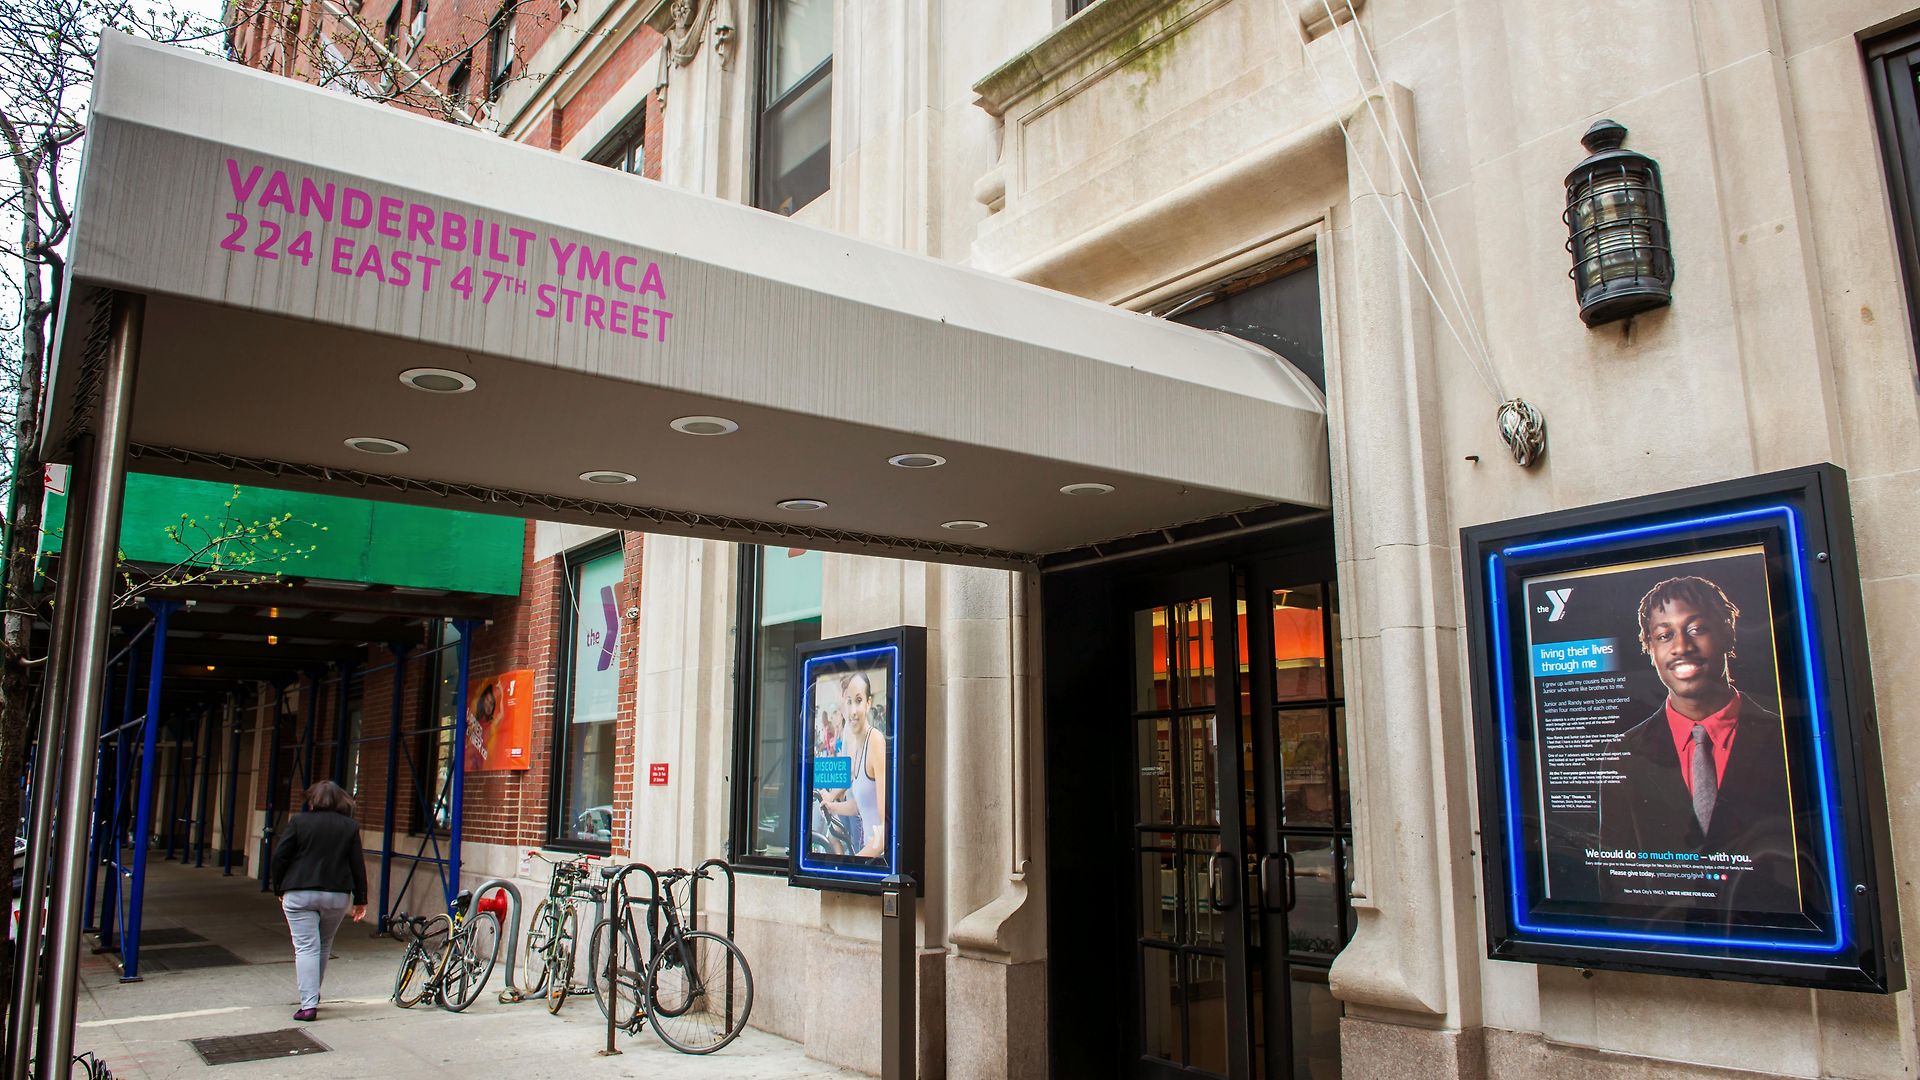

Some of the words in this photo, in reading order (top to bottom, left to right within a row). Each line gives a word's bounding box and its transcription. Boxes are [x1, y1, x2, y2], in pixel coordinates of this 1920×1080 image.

[226, 158, 537, 267] VANDERBILT
[549, 237, 667, 300] YMCA
[220, 212, 314, 266] 224
[331, 237, 441, 292] EAST
[450, 266, 527, 305] 47TH
[535, 283, 674, 342] STREET
[1537, 605, 1549, 613] the
[1545, 588, 1572, 622] Y
[587, 628, 600, 647] the
[1540, 648, 1564, 660] living
[1568, 646, 1589, 656] their
[1592, 644, 1614, 654] lives
[1542, 659, 1578, 672] through
[1582, 660, 1597, 668] me
[814, 760, 847, 771] DISCOVER
[814, 772, 848, 783] WELLNESS
[1585, 849, 1600, 858] We
[1600, 850, 1624, 859] could
[1625, 850, 1636, 859] do
[1650, 851, 1674, 860] much
[1675, 853, 1700, 861] more
[1708, 852, 1730, 862] with
[1730, 854, 1752, 864] you.
